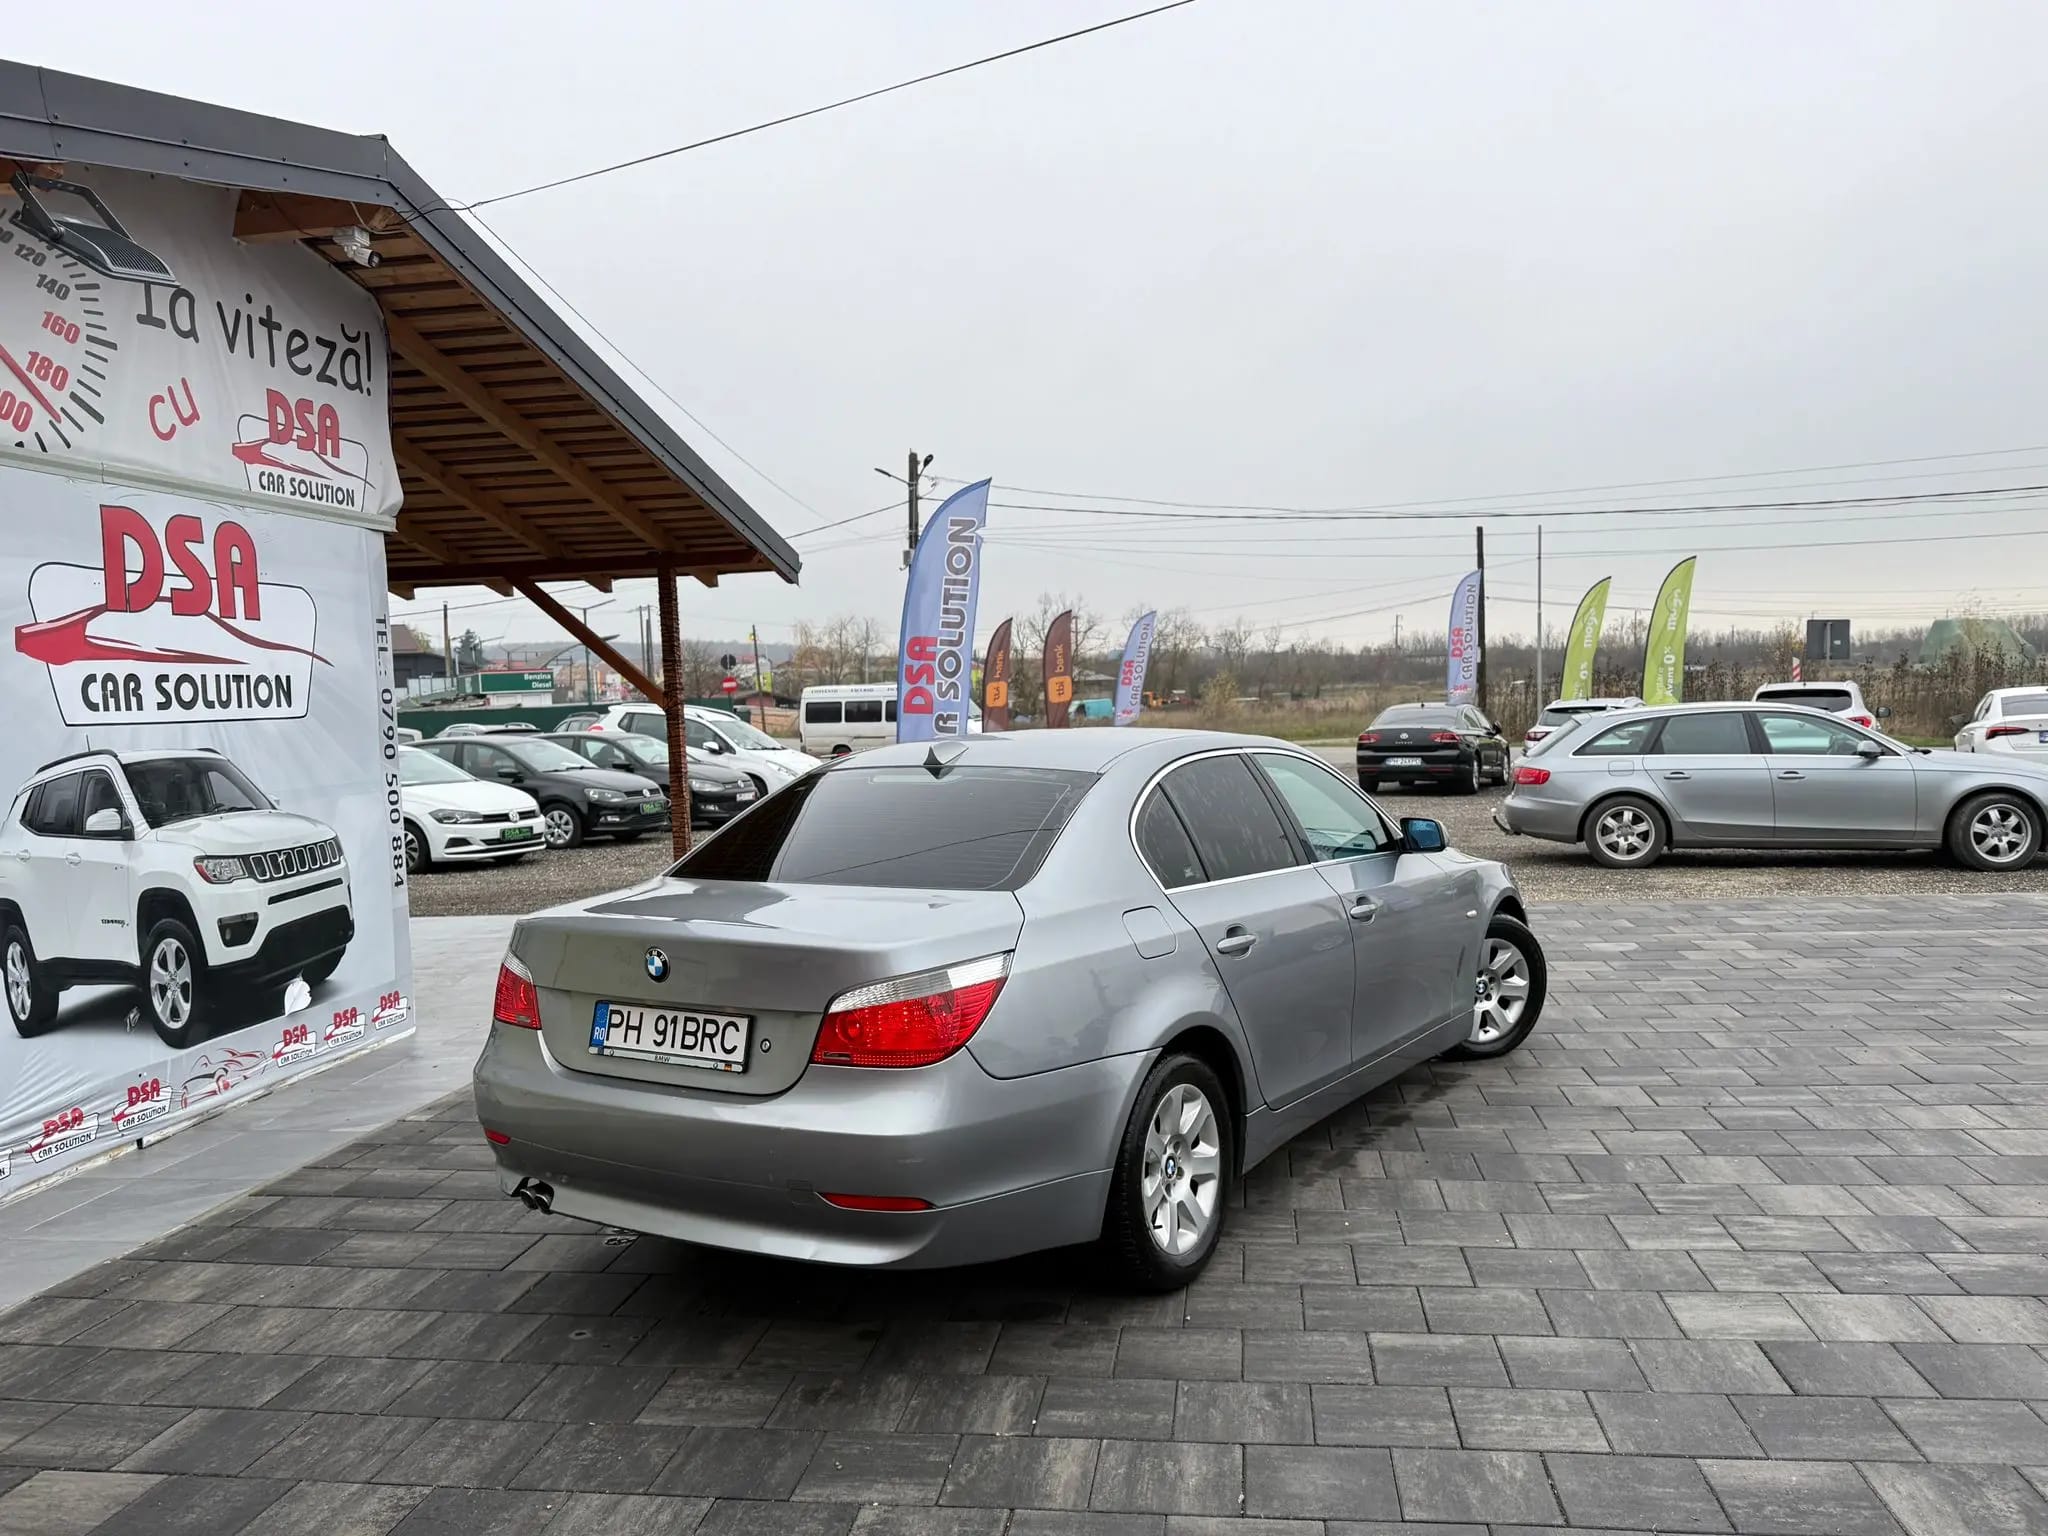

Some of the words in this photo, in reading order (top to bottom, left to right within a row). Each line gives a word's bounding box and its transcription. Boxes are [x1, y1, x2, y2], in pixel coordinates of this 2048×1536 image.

[14, 243, 47, 267] 120
[36, 273, 71, 300] 140
[41, 311, 80, 344] 160
[216, 293, 372, 397] viteză!
[26, 351, 69, 391] 180
[0, 387, 33, 433] 00
[148, 377, 200, 441] cu
[266, 388, 340, 458] DSA
[258, 470, 285, 493] CAR
[289, 476, 355, 507] SOLUTION
[100, 503, 261, 621] DSA
[936, 518, 977, 700] SOLUTION
[1463, 584, 1476, 650] SOLUTION
[1134, 623, 1150, 682] SOLUTION
[1451, 627, 1464, 658] DSA
[1055, 644, 1065, 673] bank
[1121, 660, 1135, 686] DSA
[1462, 656, 1473, 680] CAR
[903, 636, 938, 714] DSA
[81, 672, 144, 713] CAR
[155, 673, 293, 712] SOLUTION
[1129, 685, 1141, 706] CAR
[380, 687, 397, 760] 0790
[385, 772, 401, 825] 500
[391, 835, 405, 888] 884
[379, 990, 400, 1011] DSA
[333, 1006, 358, 1029] DSA
[386, 1013, 405, 1025] SOLUTION
[606, 1009, 644, 1045] PH
[652, 1014, 740, 1055] 91BRC
[282, 1023, 308, 1047] DSA
[340, 1030, 362, 1043] SOLUTION
[593, 1026, 606, 1041] RO
[290, 1048, 313, 1061] SOLUTION
[127, 1078, 160, 1107] DSA
[42, 1107, 84, 1138] DSA
[122, 1117, 136, 1128] CAR
[137, 1105, 167, 1123] SOLUTION
[38, 1148, 53, 1159] CAR
[55, 1132, 92, 1153] SOLUTION
